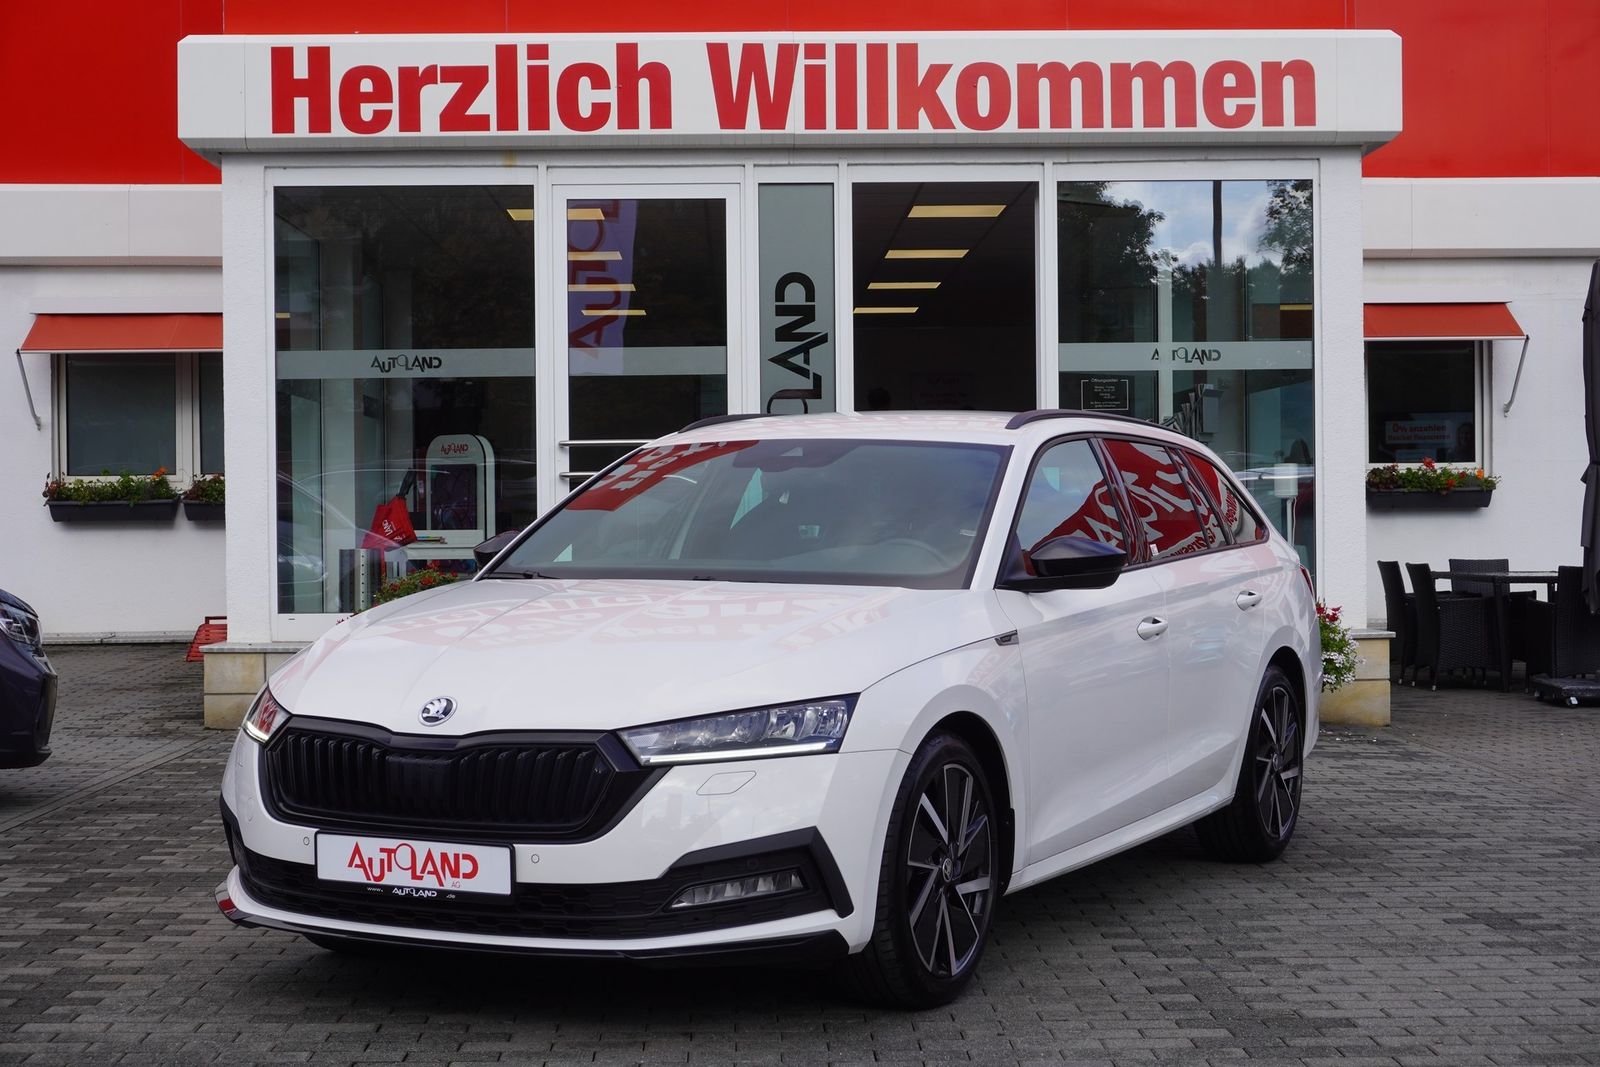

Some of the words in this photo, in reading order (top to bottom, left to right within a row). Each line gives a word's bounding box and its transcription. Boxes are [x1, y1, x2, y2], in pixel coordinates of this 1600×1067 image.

[271, 43, 671, 135] Herzlich
[707, 43, 1315, 134] Willkommen
[370, 354, 443, 373] AUTOLAND
[1151, 346, 1222, 365] ATOLAND
[347, 841, 479, 888] AUTOLAND
[392, 887, 438, 898] AUTOLAND
